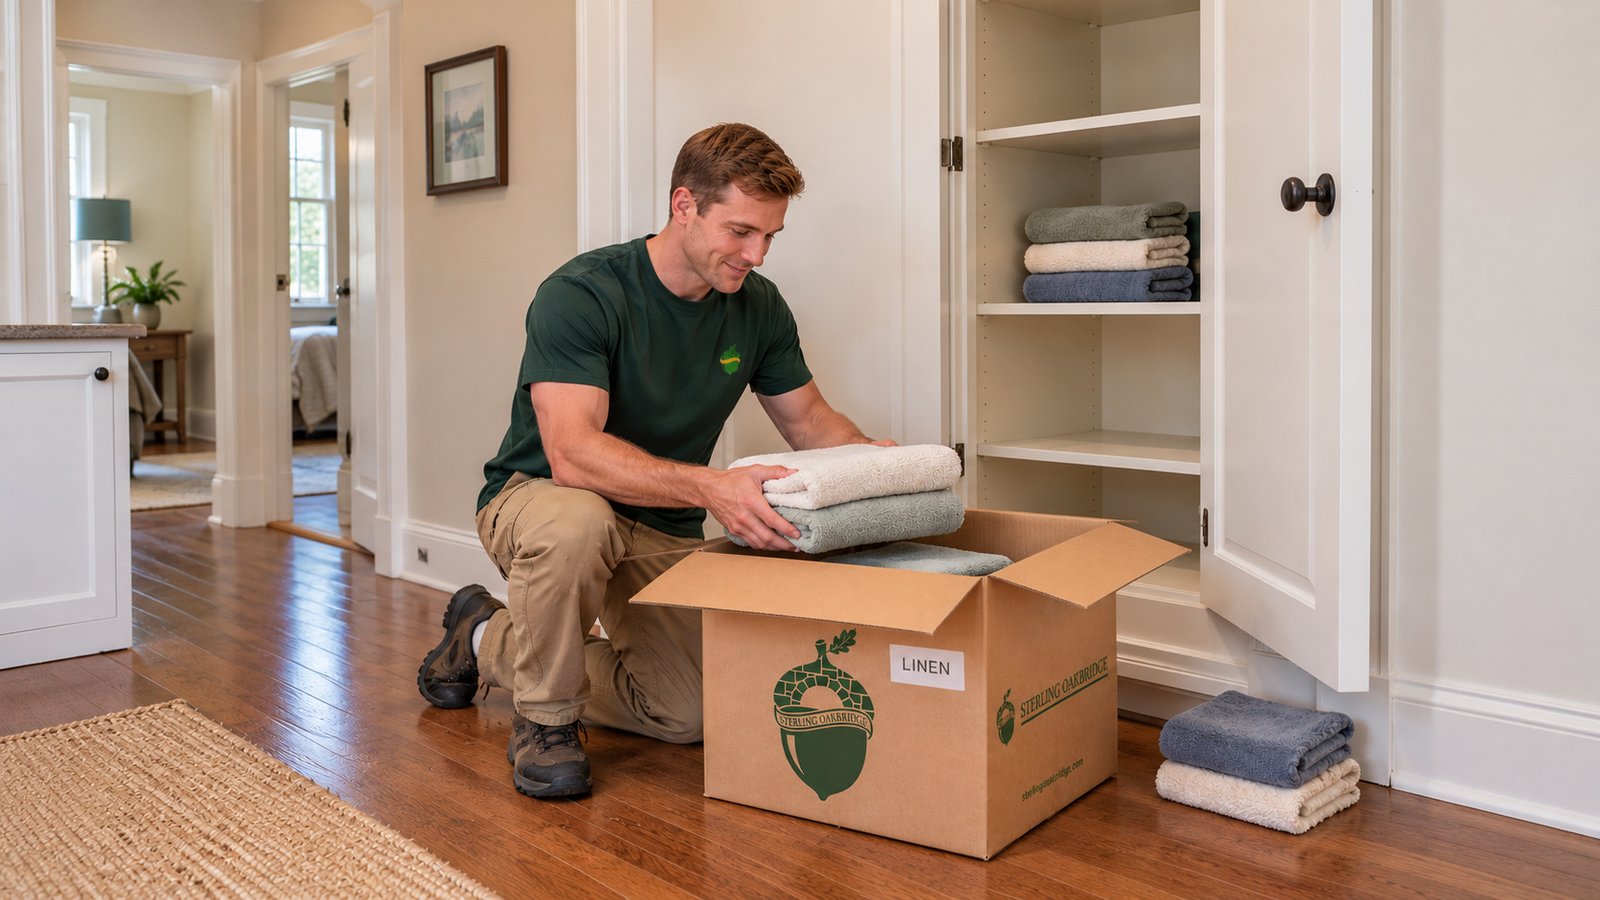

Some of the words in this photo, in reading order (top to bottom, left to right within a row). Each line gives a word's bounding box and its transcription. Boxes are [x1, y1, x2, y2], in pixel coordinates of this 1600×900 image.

[902, 657, 950, 675] LINEN
[1020, 682, 1060, 719] STERLING
[1061, 656, 1109, 694] OAKBRIDGE
[779, 715, 818, 727] STERLING
[819, 712, 867, 726] OAKBRIDGE
